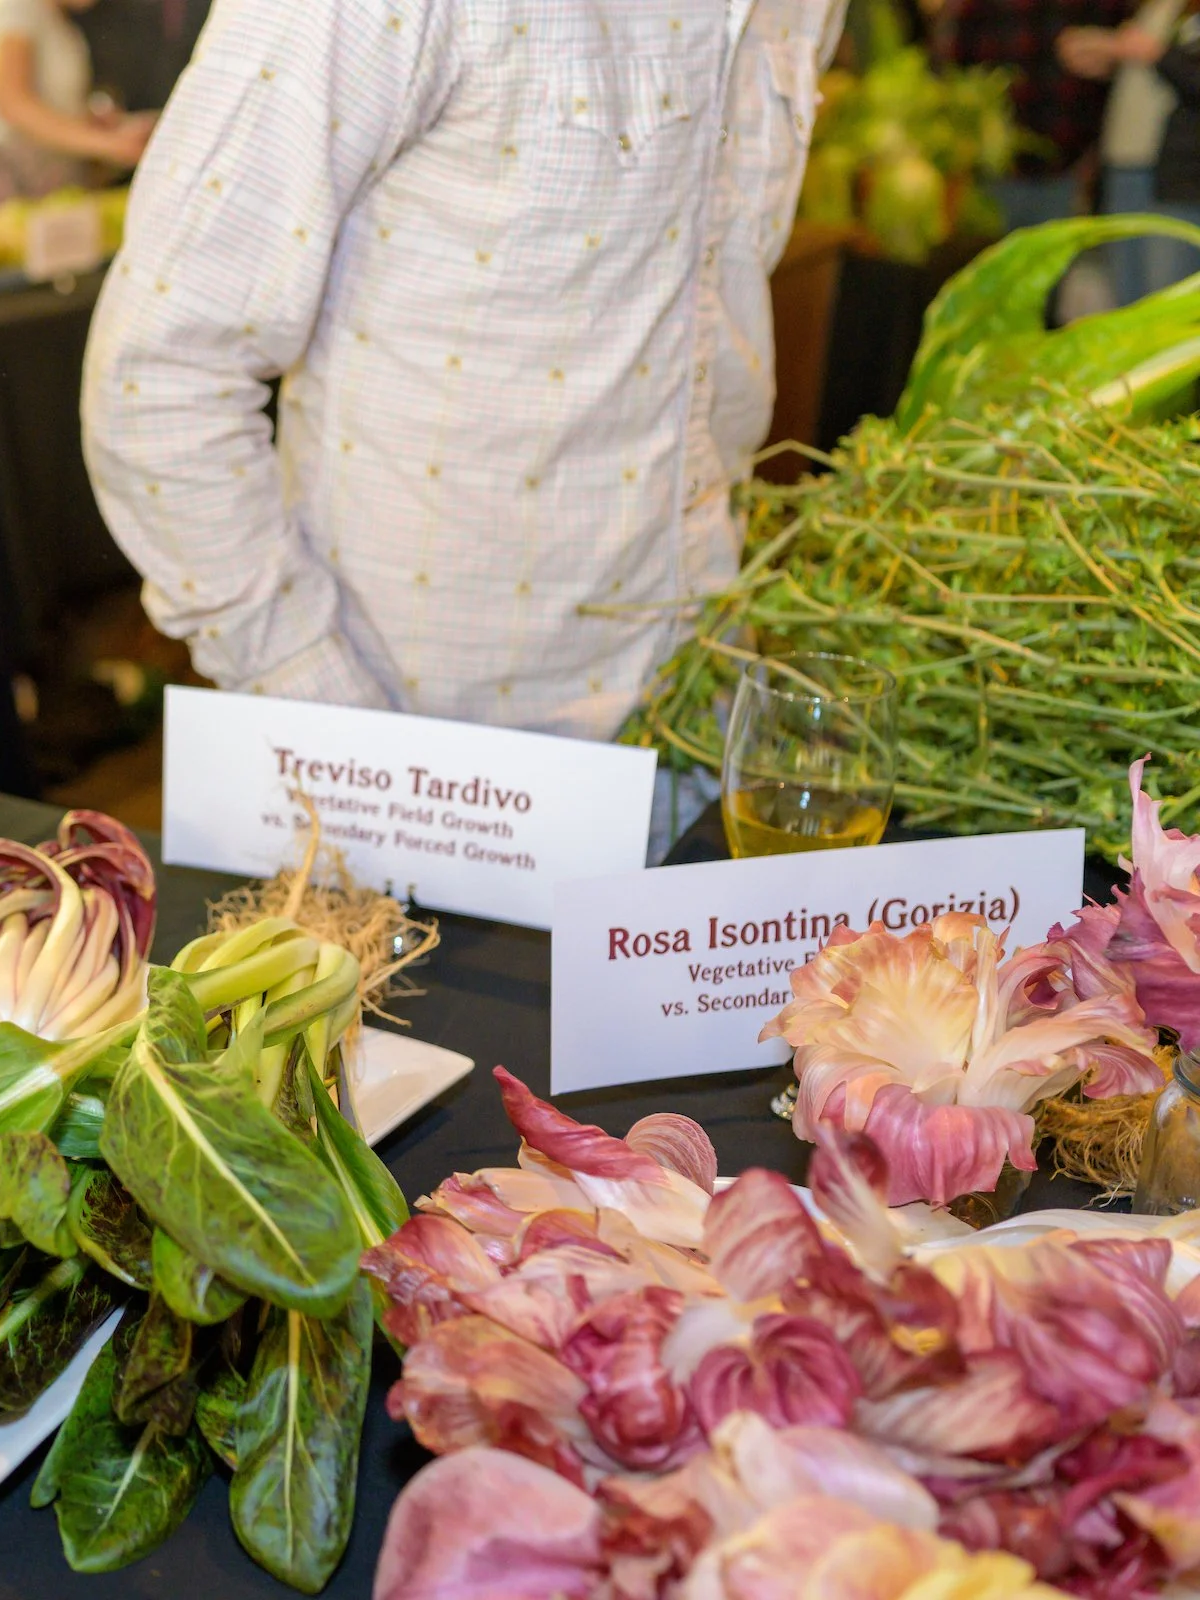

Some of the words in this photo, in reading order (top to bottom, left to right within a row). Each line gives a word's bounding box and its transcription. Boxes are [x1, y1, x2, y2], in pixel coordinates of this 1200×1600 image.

[273, 746, 392, 791] Treviso
[408, 766, 532, 814] Tardivo
[388, 801, 434, 825] Field
[441, 811, 514, 840] Growth
[394, 829, 456, 856] Forced
[463, 841, 537, 871] Growth
[608, 927, 691, 960] Rosa
[708, 908, 850, 949] Isontina
[688, 956, 795, 985] Vegetative
[661, 1001, 689, 1017] vs.
[697, 987, 795, 1013] Secondar
